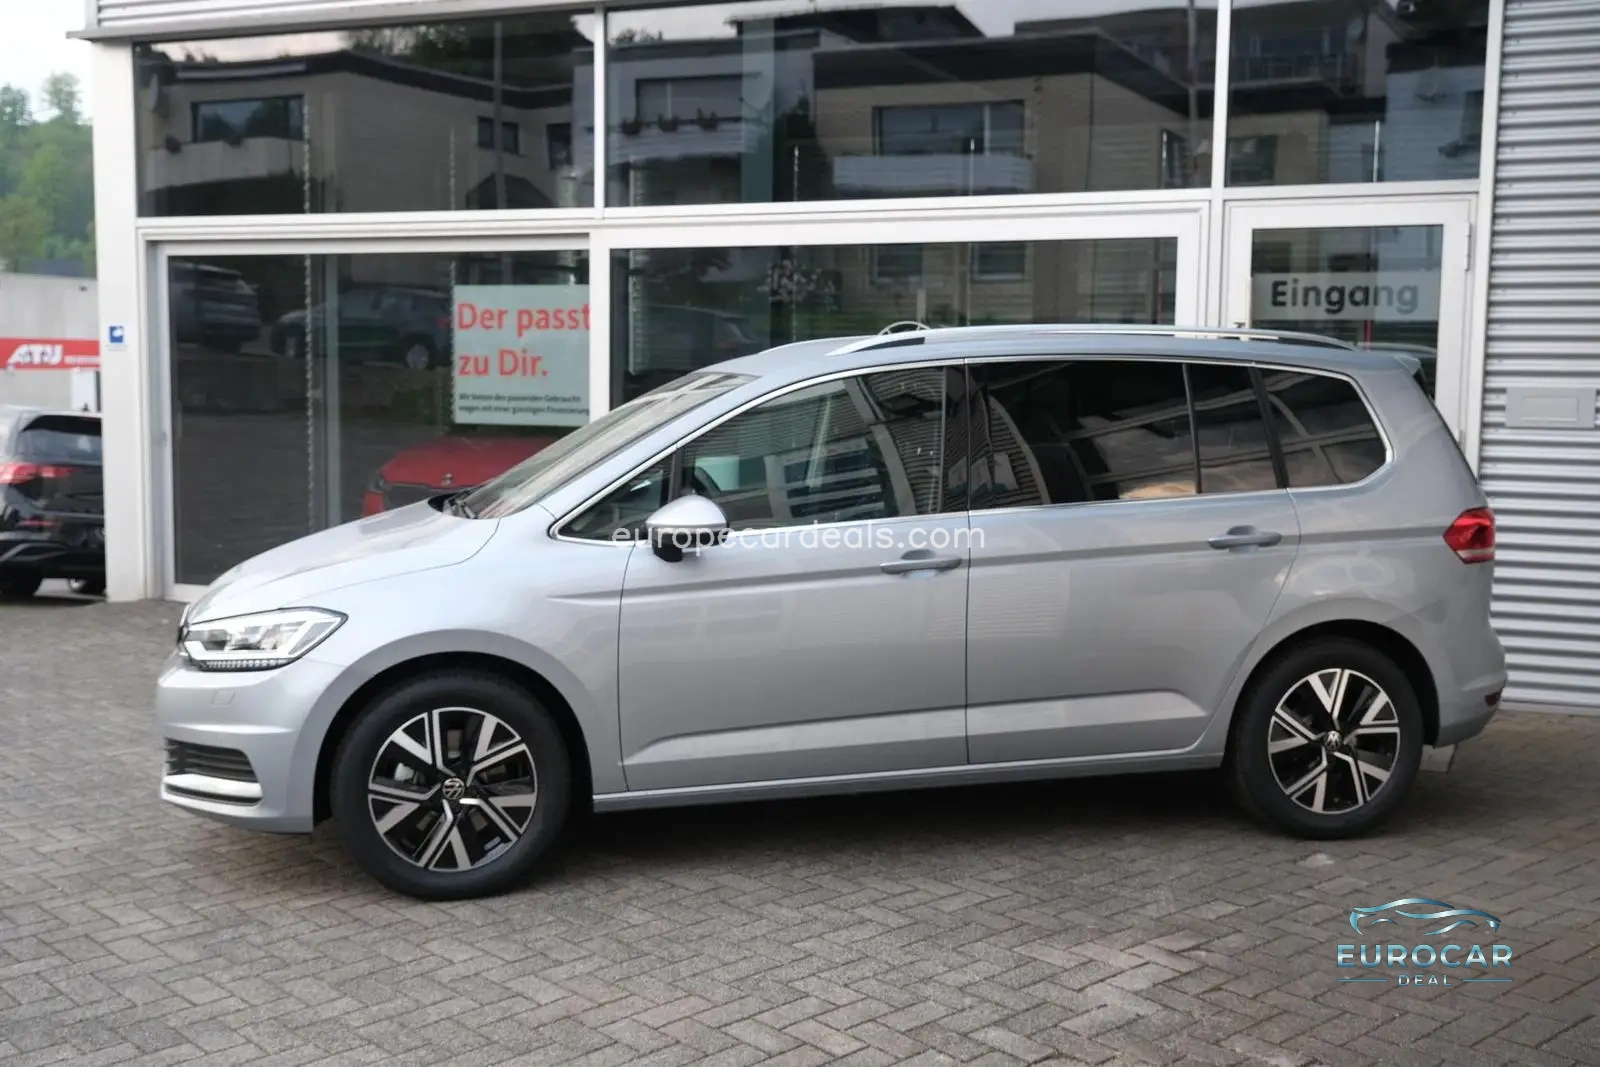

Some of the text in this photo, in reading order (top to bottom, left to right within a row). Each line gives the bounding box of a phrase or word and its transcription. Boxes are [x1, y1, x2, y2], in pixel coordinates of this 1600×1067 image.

[1271, 277, 1418, 315] Eingang
[457, 303, 590, 338] Der passt
[458, 348, 549, 377] zu Dir.
